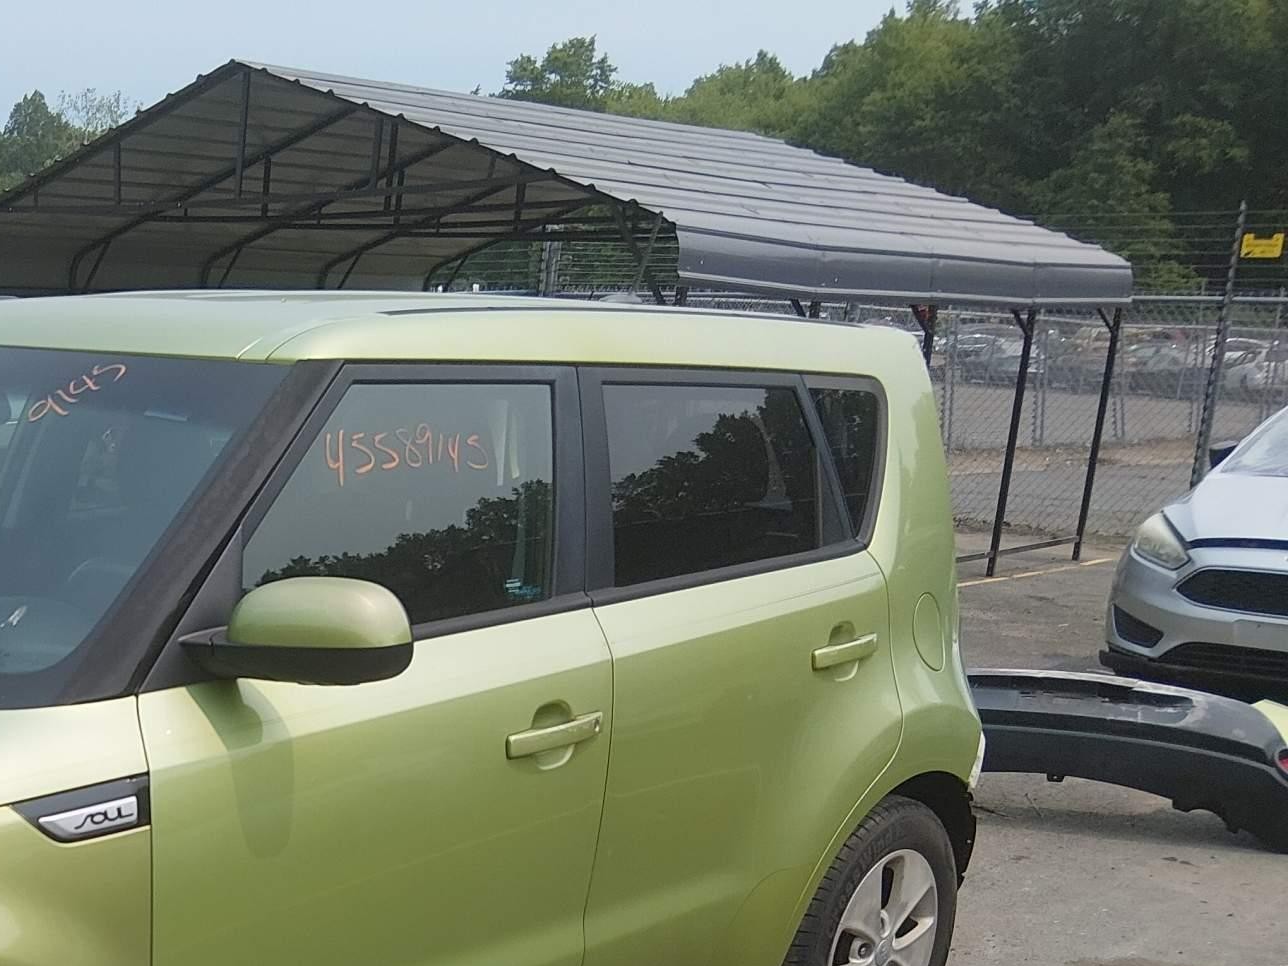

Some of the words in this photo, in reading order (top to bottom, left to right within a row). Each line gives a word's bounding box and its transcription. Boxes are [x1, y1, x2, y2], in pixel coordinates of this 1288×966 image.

[28, 363, 127, 422] 9145
[326, 423, 489, 487] 45589145
[74, 807, 134, 830] SOUL
